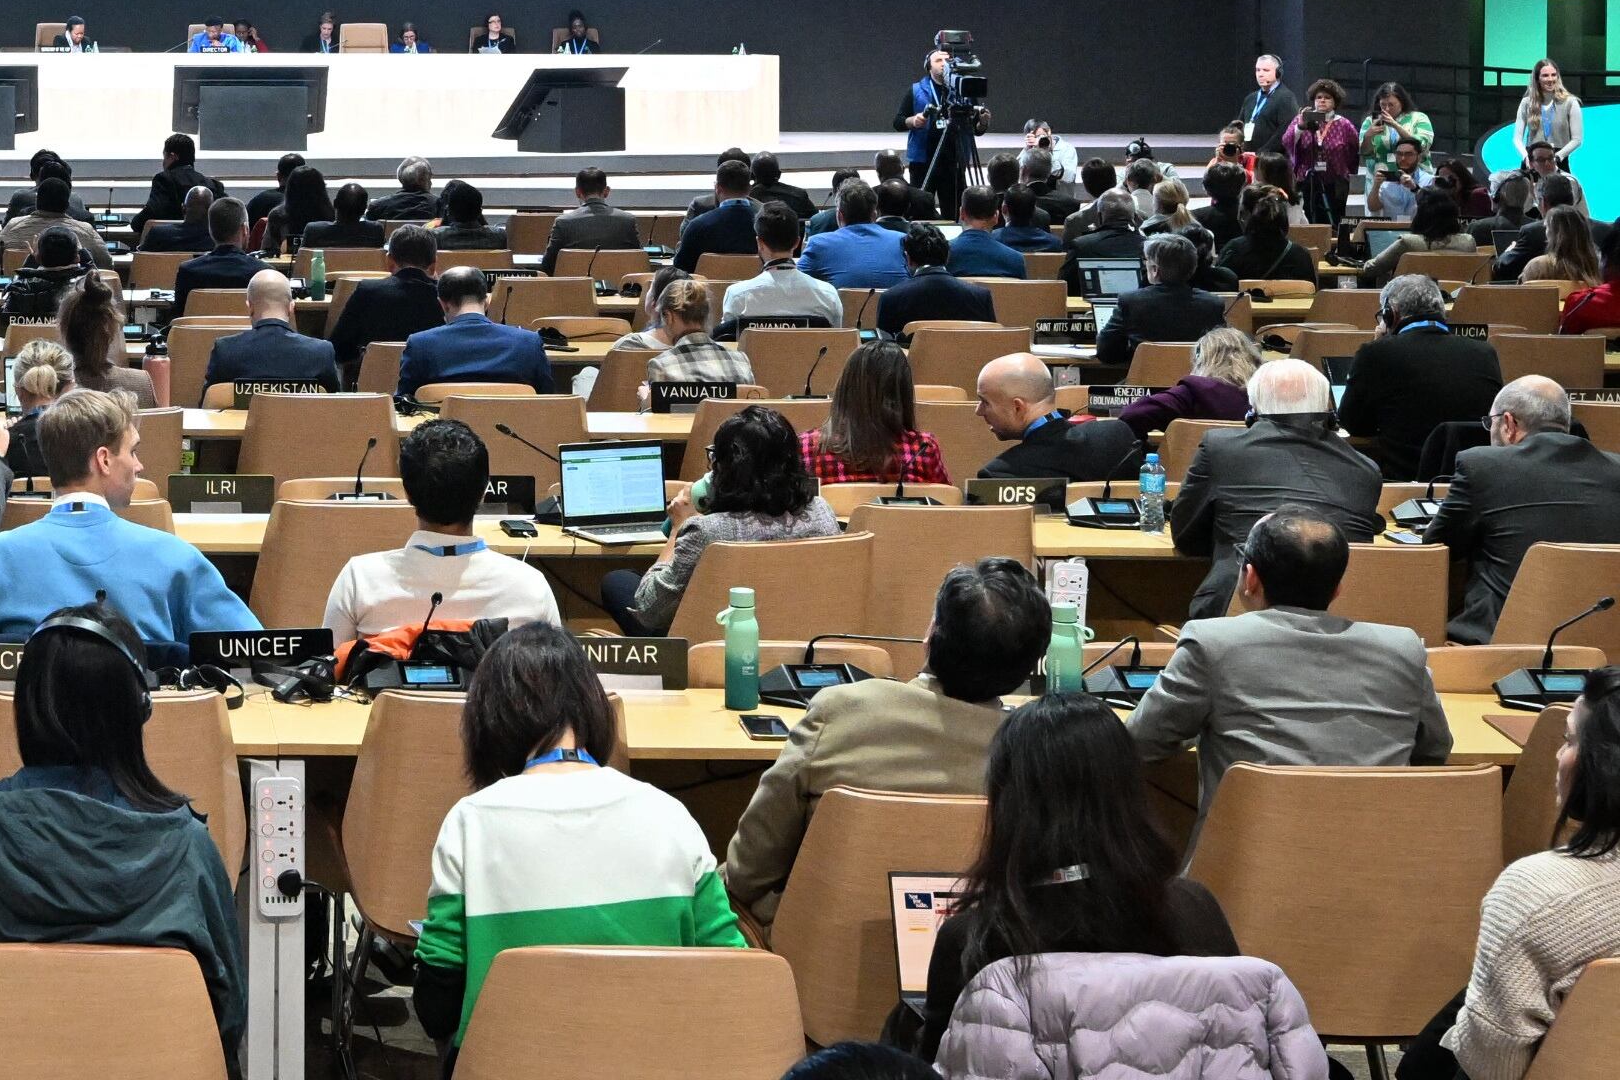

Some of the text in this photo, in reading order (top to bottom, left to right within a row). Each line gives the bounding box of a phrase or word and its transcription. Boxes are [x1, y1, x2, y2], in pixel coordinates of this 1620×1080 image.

[9, 315, 60, 326] ROMANI
[1035, 322, 1051, 332] SAINT
[1053, 322, 1068, 332] KITTS
[1070, 322, 1082, 332] AND
[1455, 327, 1487, 337] LUCIA
[235, 383, 318, 395] UZBEKISTAN
[660, 386, 728, 398] VANUATU
[1113, 387, 1151, 397] VENEZUELA
[206, 480, 236, 495] ILRI
[998, 486, 1036, 503] IOFS
[219, 636, 303, 658] UNICEF
[582, 644, 658, 664] NITAR
